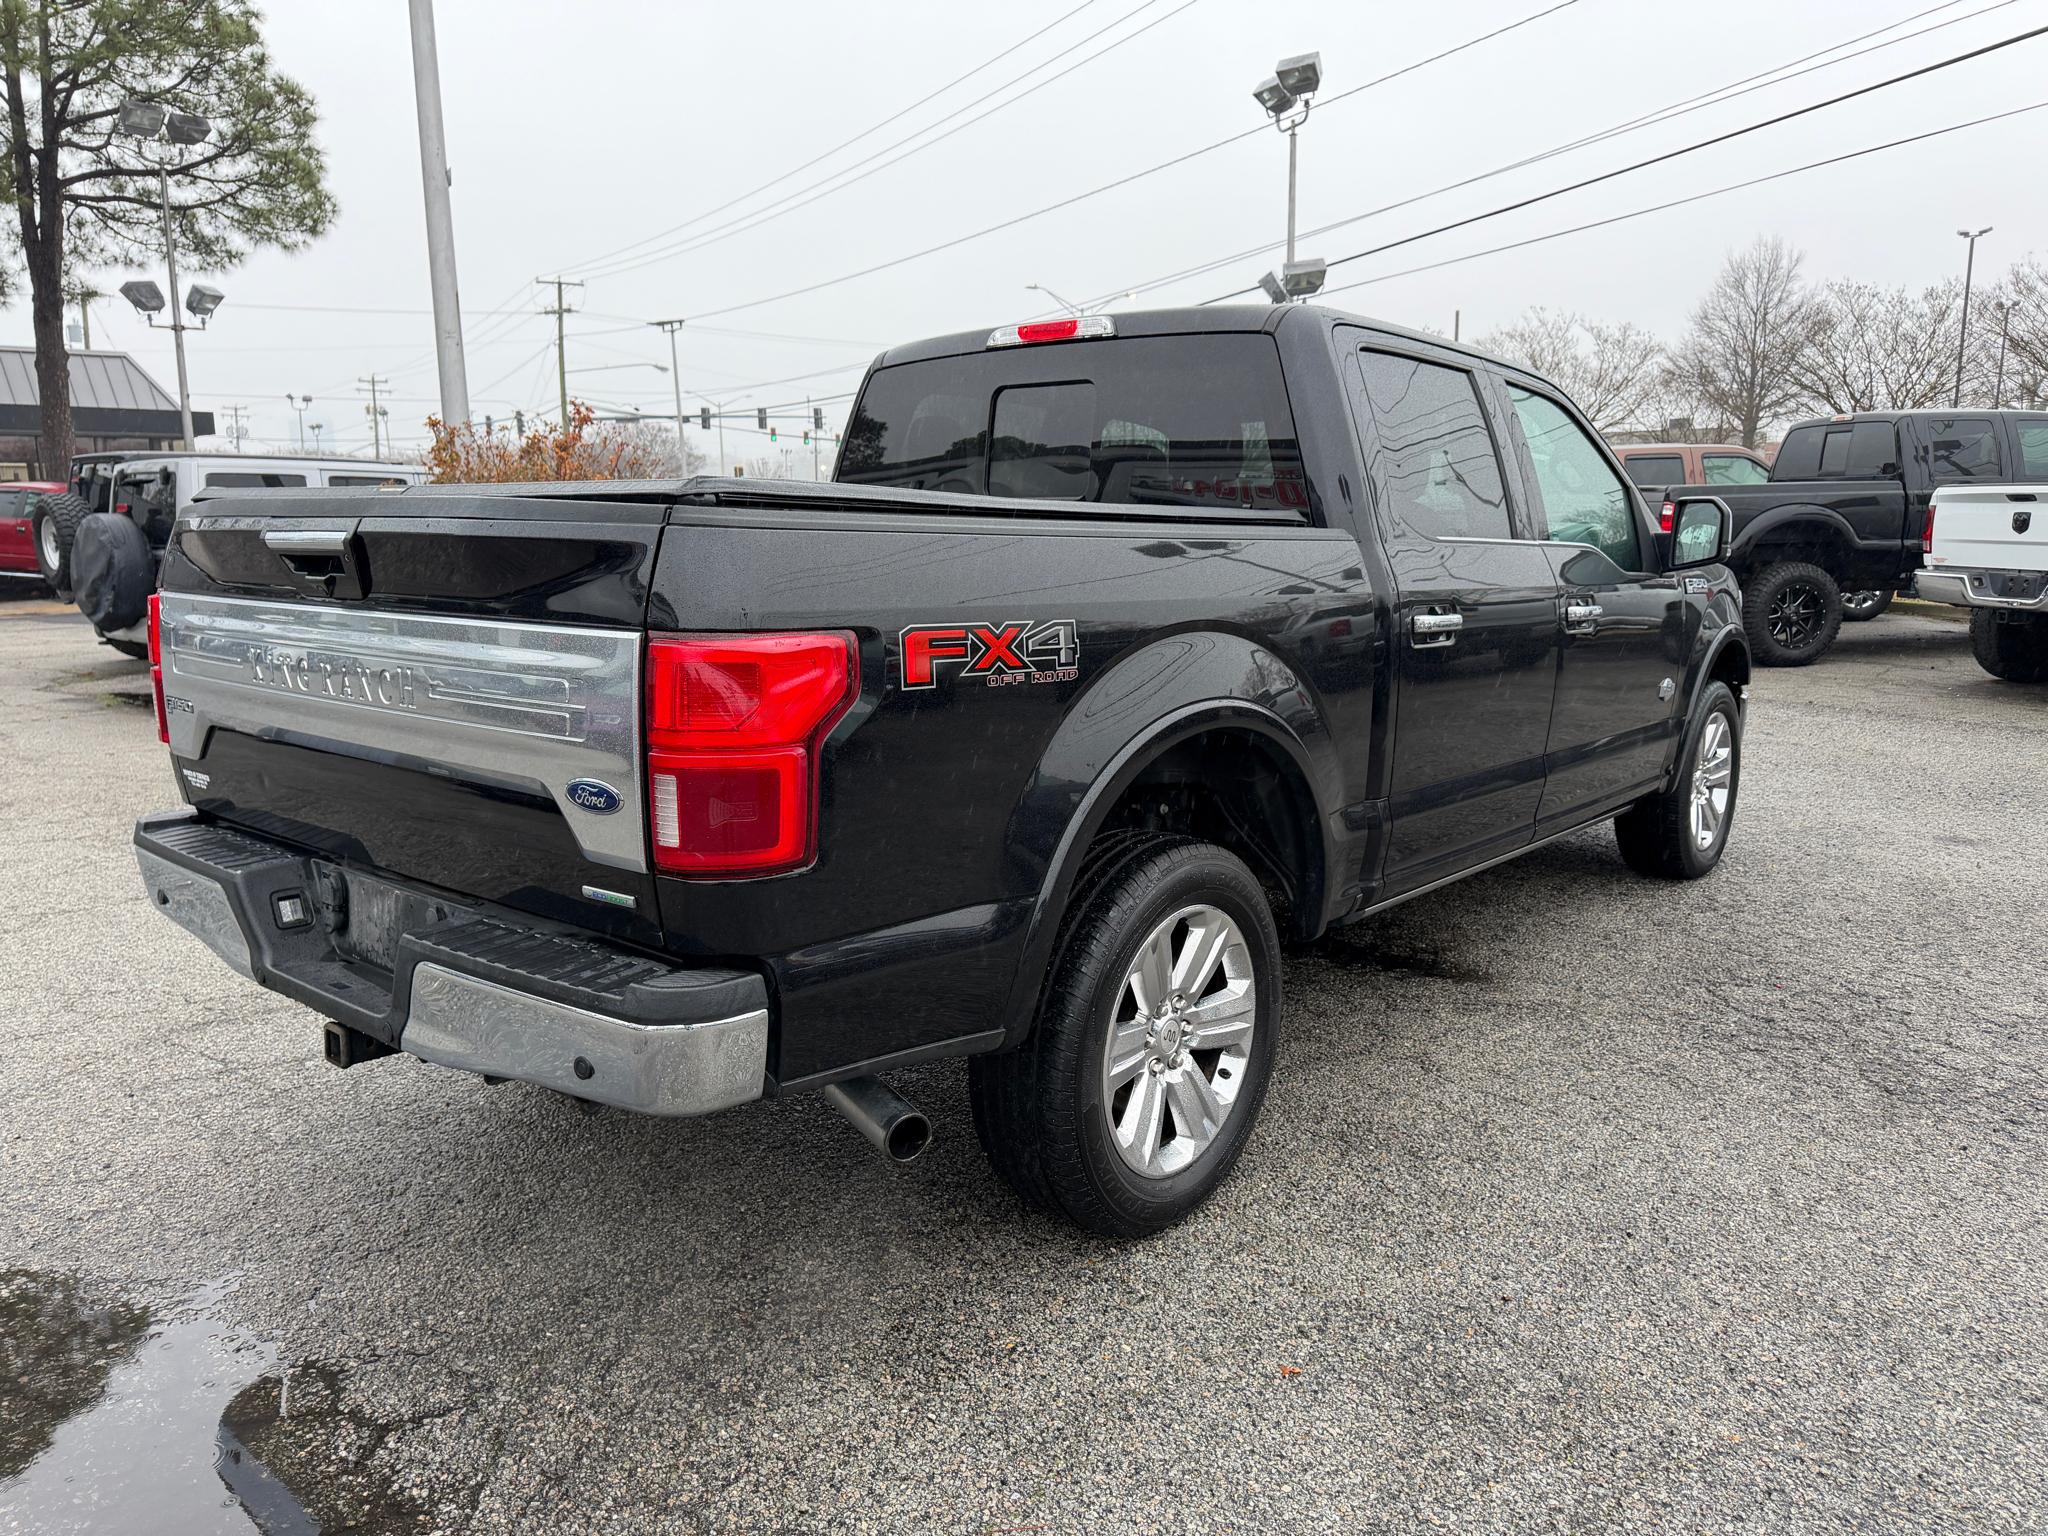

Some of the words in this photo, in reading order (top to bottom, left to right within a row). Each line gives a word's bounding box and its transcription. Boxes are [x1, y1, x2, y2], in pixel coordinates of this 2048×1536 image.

[900, 620, 1079, 690] FX4
[249, 647, 309, 691] KING
[320, 662, 416, 709] RANCH
[987, 673, 1025, 687] OFF
[1031, 669, 1079, 684] ROAD
[575, 785, 607, 808] Ford
